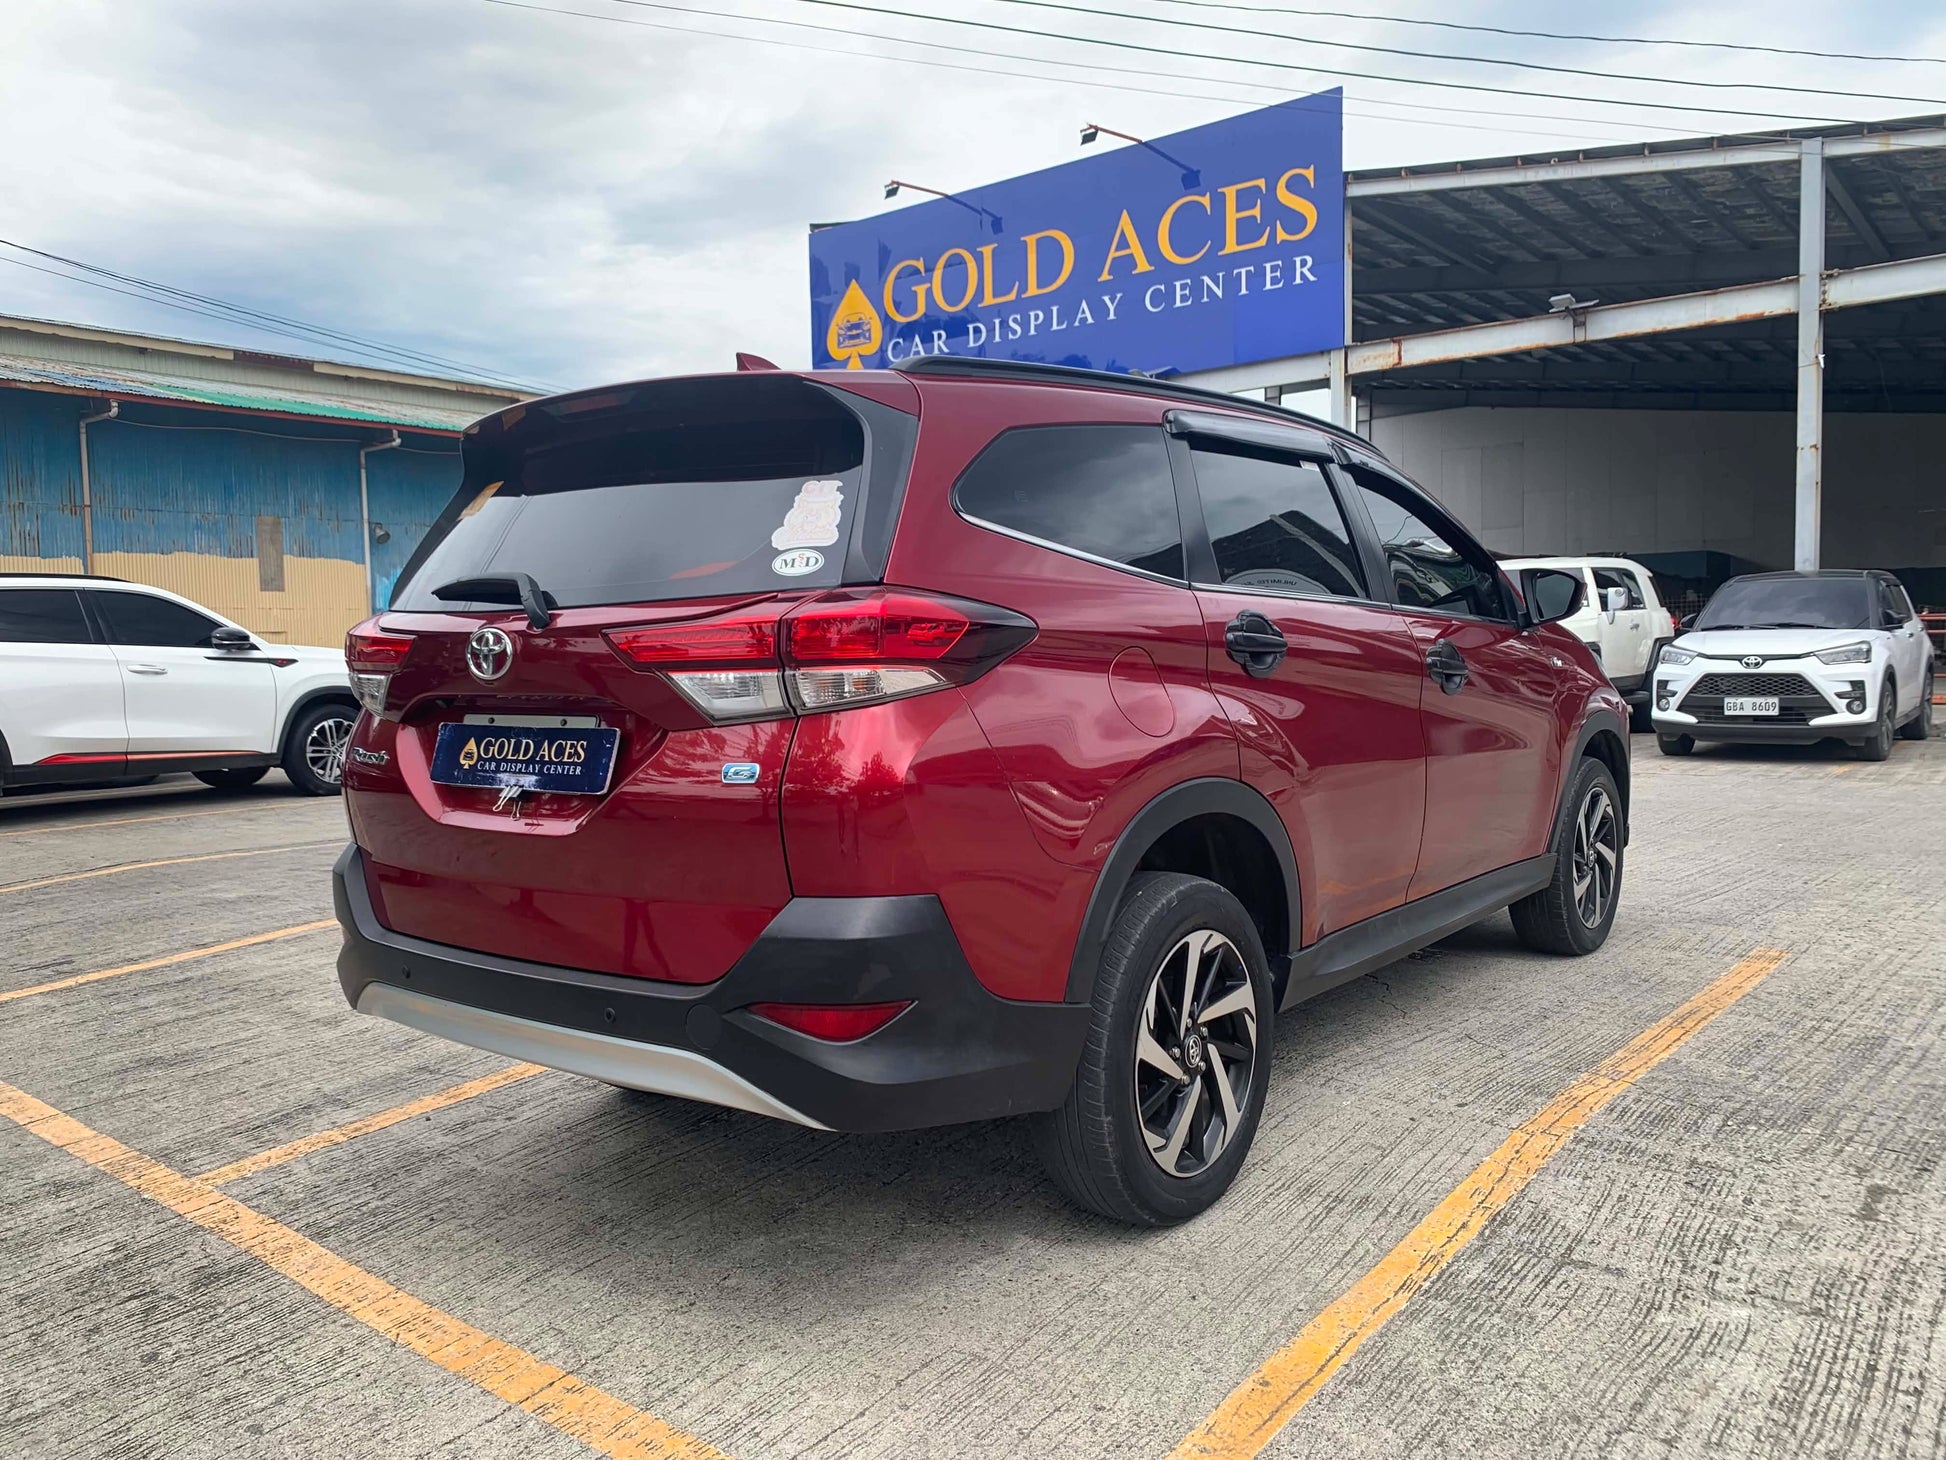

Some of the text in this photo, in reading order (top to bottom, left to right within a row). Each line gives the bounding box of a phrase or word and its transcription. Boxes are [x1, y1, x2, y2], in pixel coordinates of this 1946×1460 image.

[883, 164, 1318, 323] GOLD ACES
[887, 254, 1318, 362] CAR DISPLAY CENTER
[1726, 701, 1777, 711] GBA 8609
[480, 737, 587, 763] GOLD ACES
[477, 760, 582, 775] CAR DISPLAY CENTER
